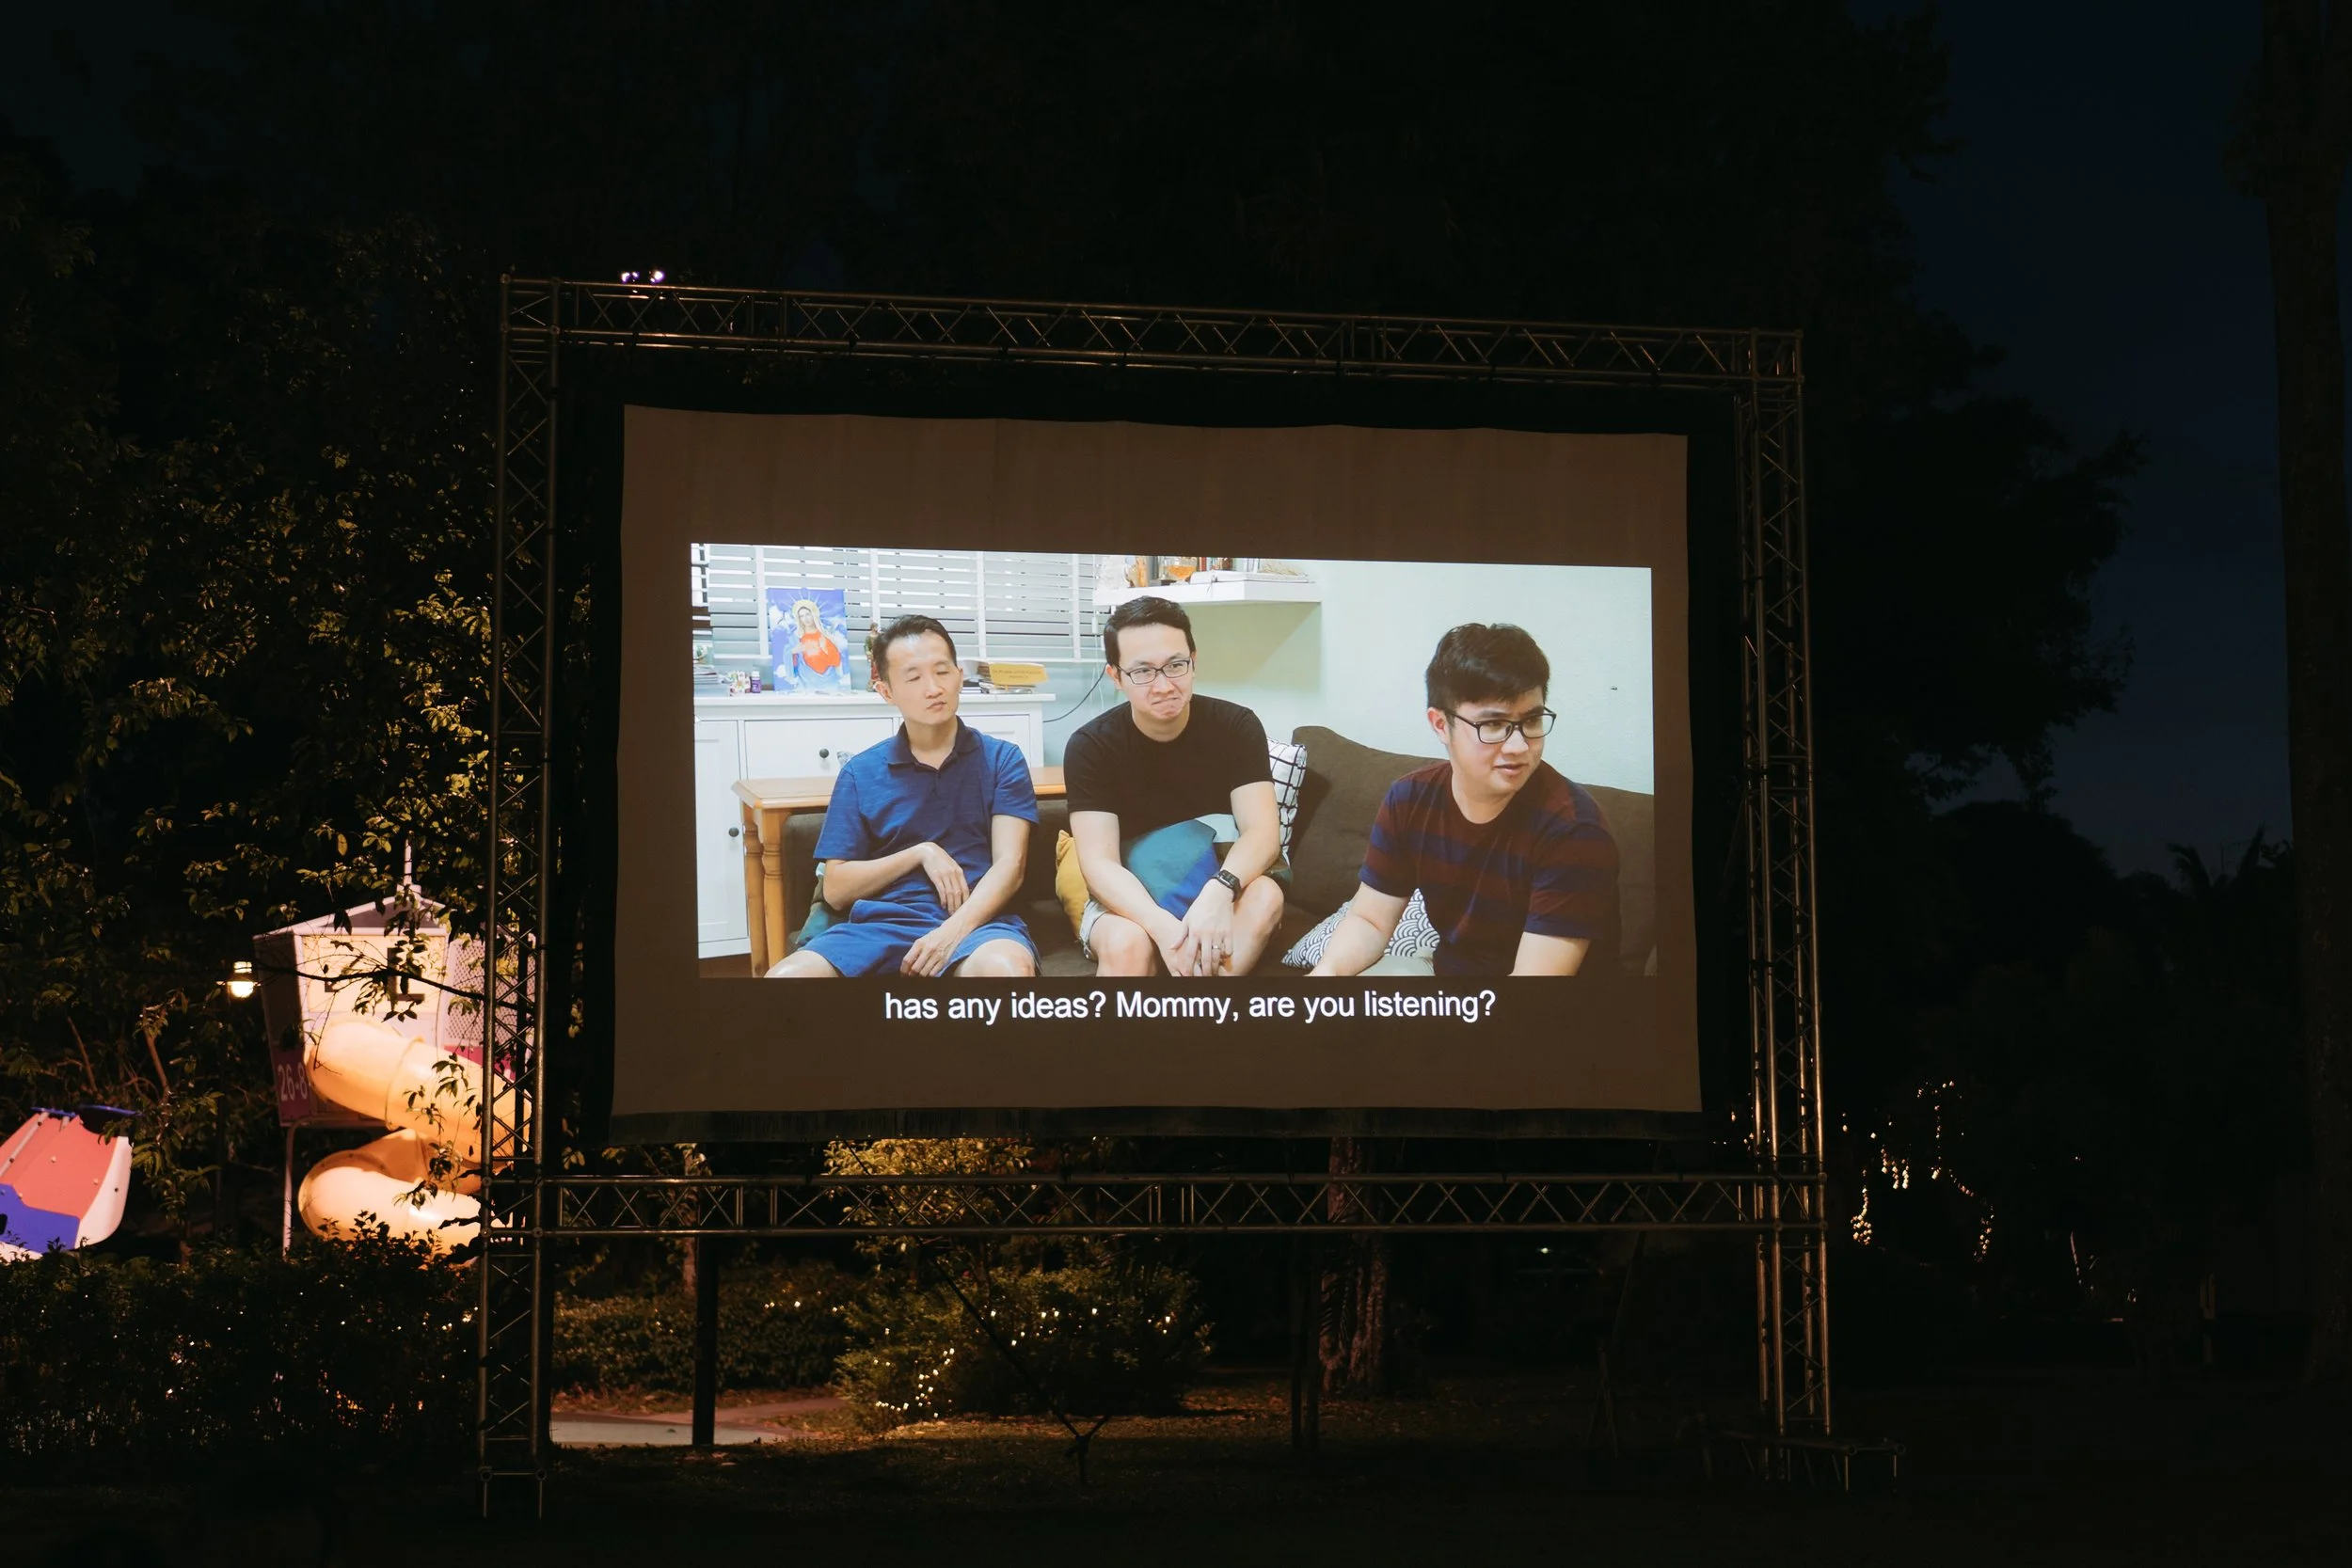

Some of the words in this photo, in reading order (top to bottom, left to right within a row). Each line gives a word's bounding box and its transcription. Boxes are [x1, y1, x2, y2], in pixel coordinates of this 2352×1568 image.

[885, 991, 939, 1019] has
[947, 996, 1002, 1025] any
[1010, 990, 1107, 1019] ideas?
[1116, 990, 1239, 1024] Mommy,
[1248, 996, 1295, 1018] are
[1303, 996, 1356, 1024] you
[1364, 990, 1496, 1023] listening?
